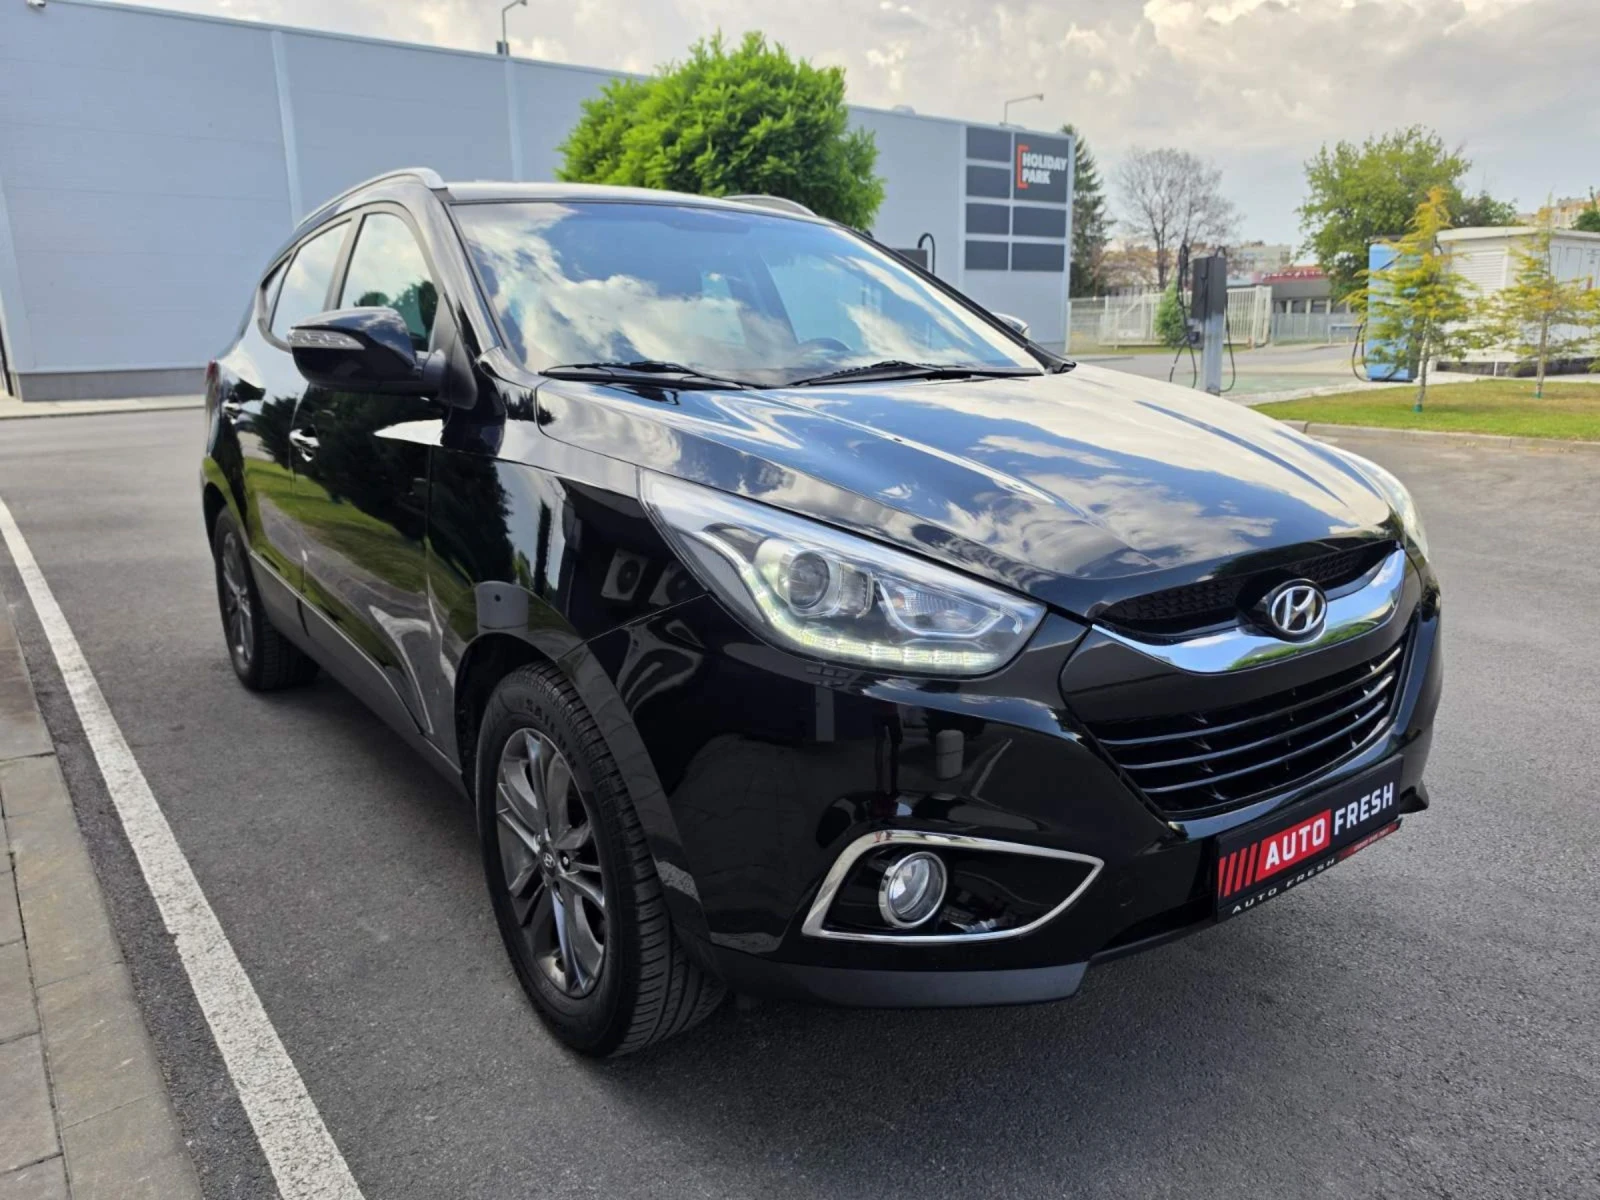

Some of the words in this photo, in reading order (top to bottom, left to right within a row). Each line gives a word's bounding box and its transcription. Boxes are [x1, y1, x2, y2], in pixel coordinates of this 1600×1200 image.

[1022, 152, 1067, 171] HOLIDAY
[1022, 168, 1051, 184] PARK
[1265, 818, 1326, 871] AUTO
[1334, 782, 1394, 836] FRESH
[1232, 887, 1278, 914] AUTO
[1286, 857, 1335, 888] FRESH
